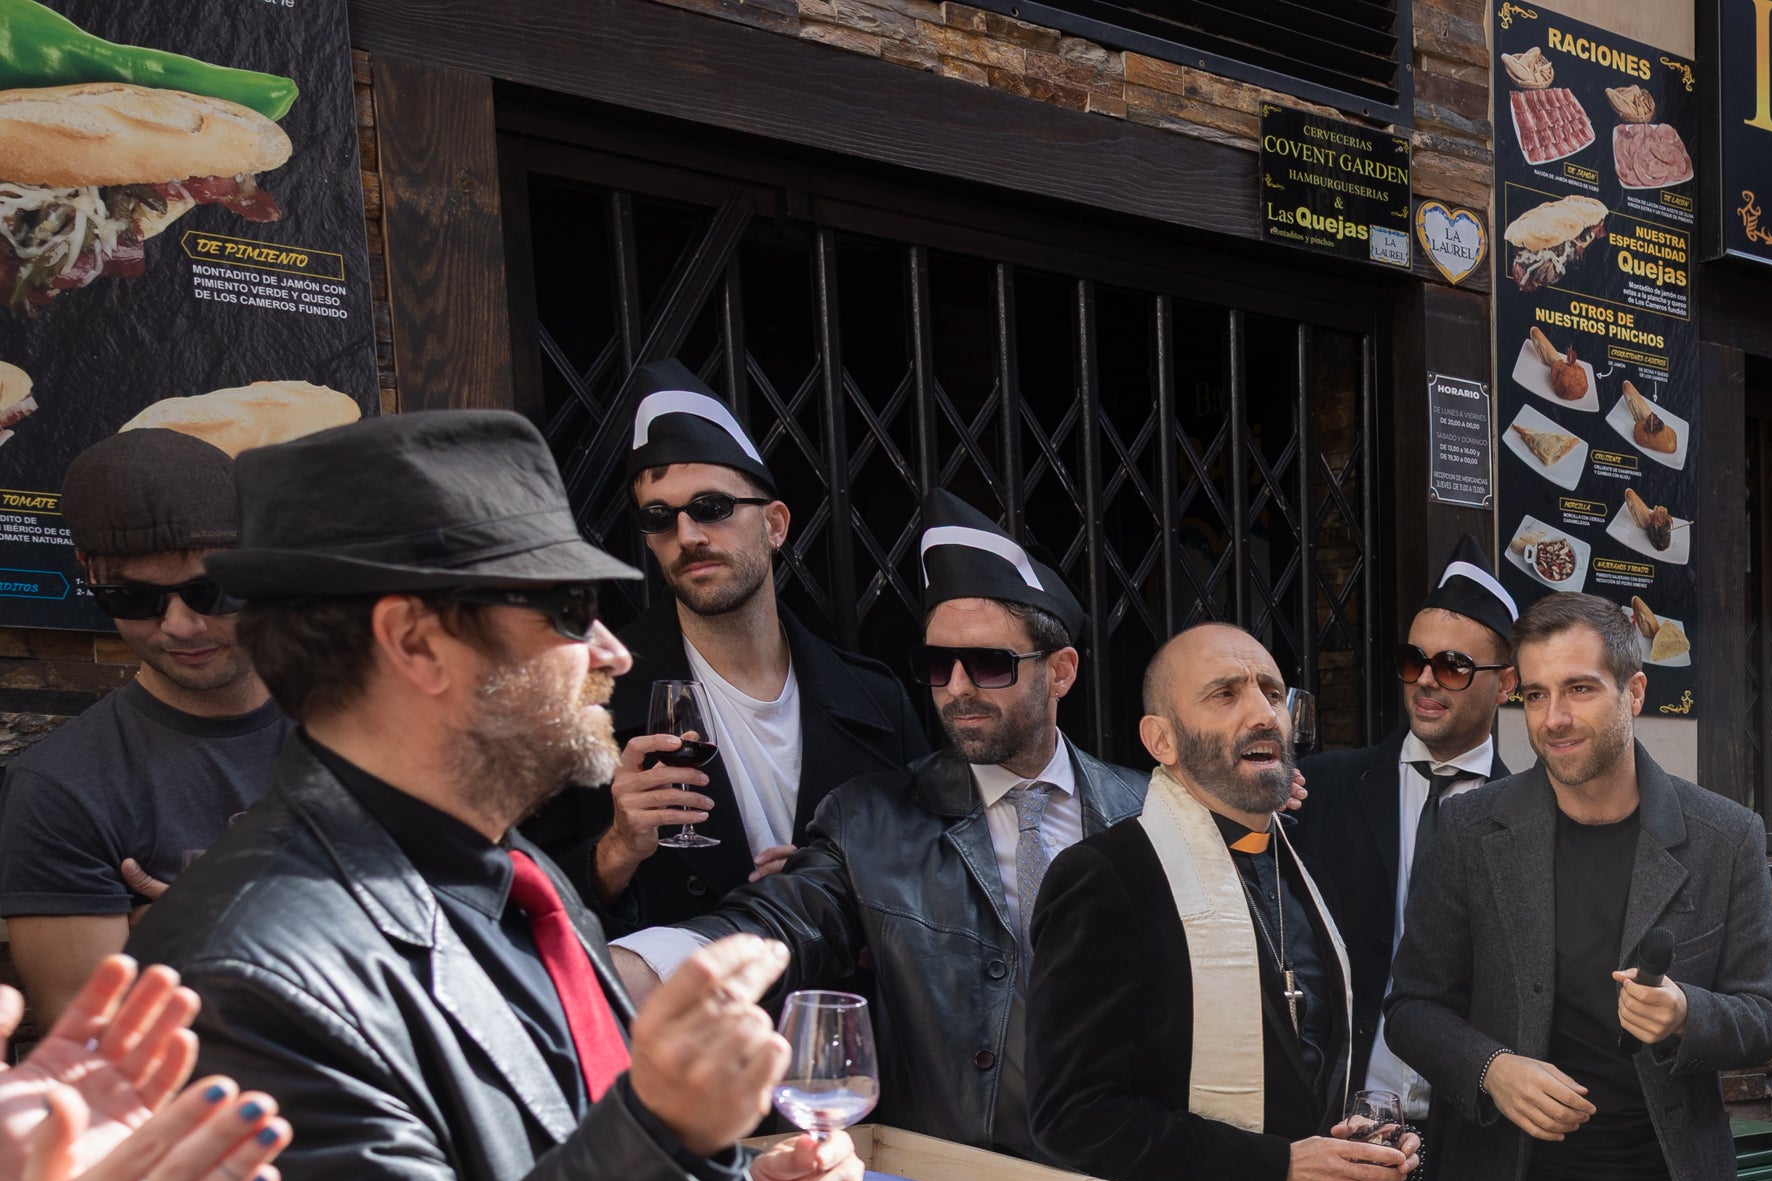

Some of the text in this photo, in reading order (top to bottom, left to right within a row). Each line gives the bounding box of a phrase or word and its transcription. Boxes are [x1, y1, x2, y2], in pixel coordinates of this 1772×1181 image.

[1548, 27, 1651, 81] RACIONES
[1303, 125, 1372, 152] CERVECERIAS
[1264, 135, 1408, 185] COVENT GARDEN
[1289, 169, 1389, 201] HAMBURGUESERIAS
[1334, 197, 1344, 209] &
[1267, 202, 1369, 240] Las Quejas
[1310, 234, 1334, 247] pinchos
[1385, 237, 1397, 248] LA
[1445, 228, 1462, 243] LA
[1636, 226, 1686, 249] NUESTRA
[197, 239, 309, 267] DE PIMIENTO
[1375, 247, 1406, 261] LAUREL
[1430, 238, 1475, 261] LAUREL
[1609, 233, 1686, 263] ESPECIALIDAD
[192, 265, 346, 295] MONTADITO DE JAMÓN CON
[1618, 251, 1687, 286] Quejas
[194, 277, 340, 306] PIMIENTO VERDE Y QUESO
[1629, 281, 1653, 294] Montadito
[195, 289, 348, 319] DE LOS CAMEROS FUNDIDO
[1570, 301, 1634, 327] OTROS DE
[1535, 307, 1665, 349] NUESTROS PINCHOS
[1437, 385, 1480, 400] HORARIO
[3, 494, 58, 508] TOMATE
[0, 515, 37, 524] DITO DE
[4, 524, 42, 534] IBÉRICO
[32, 536, 75, 546] NATURAL
